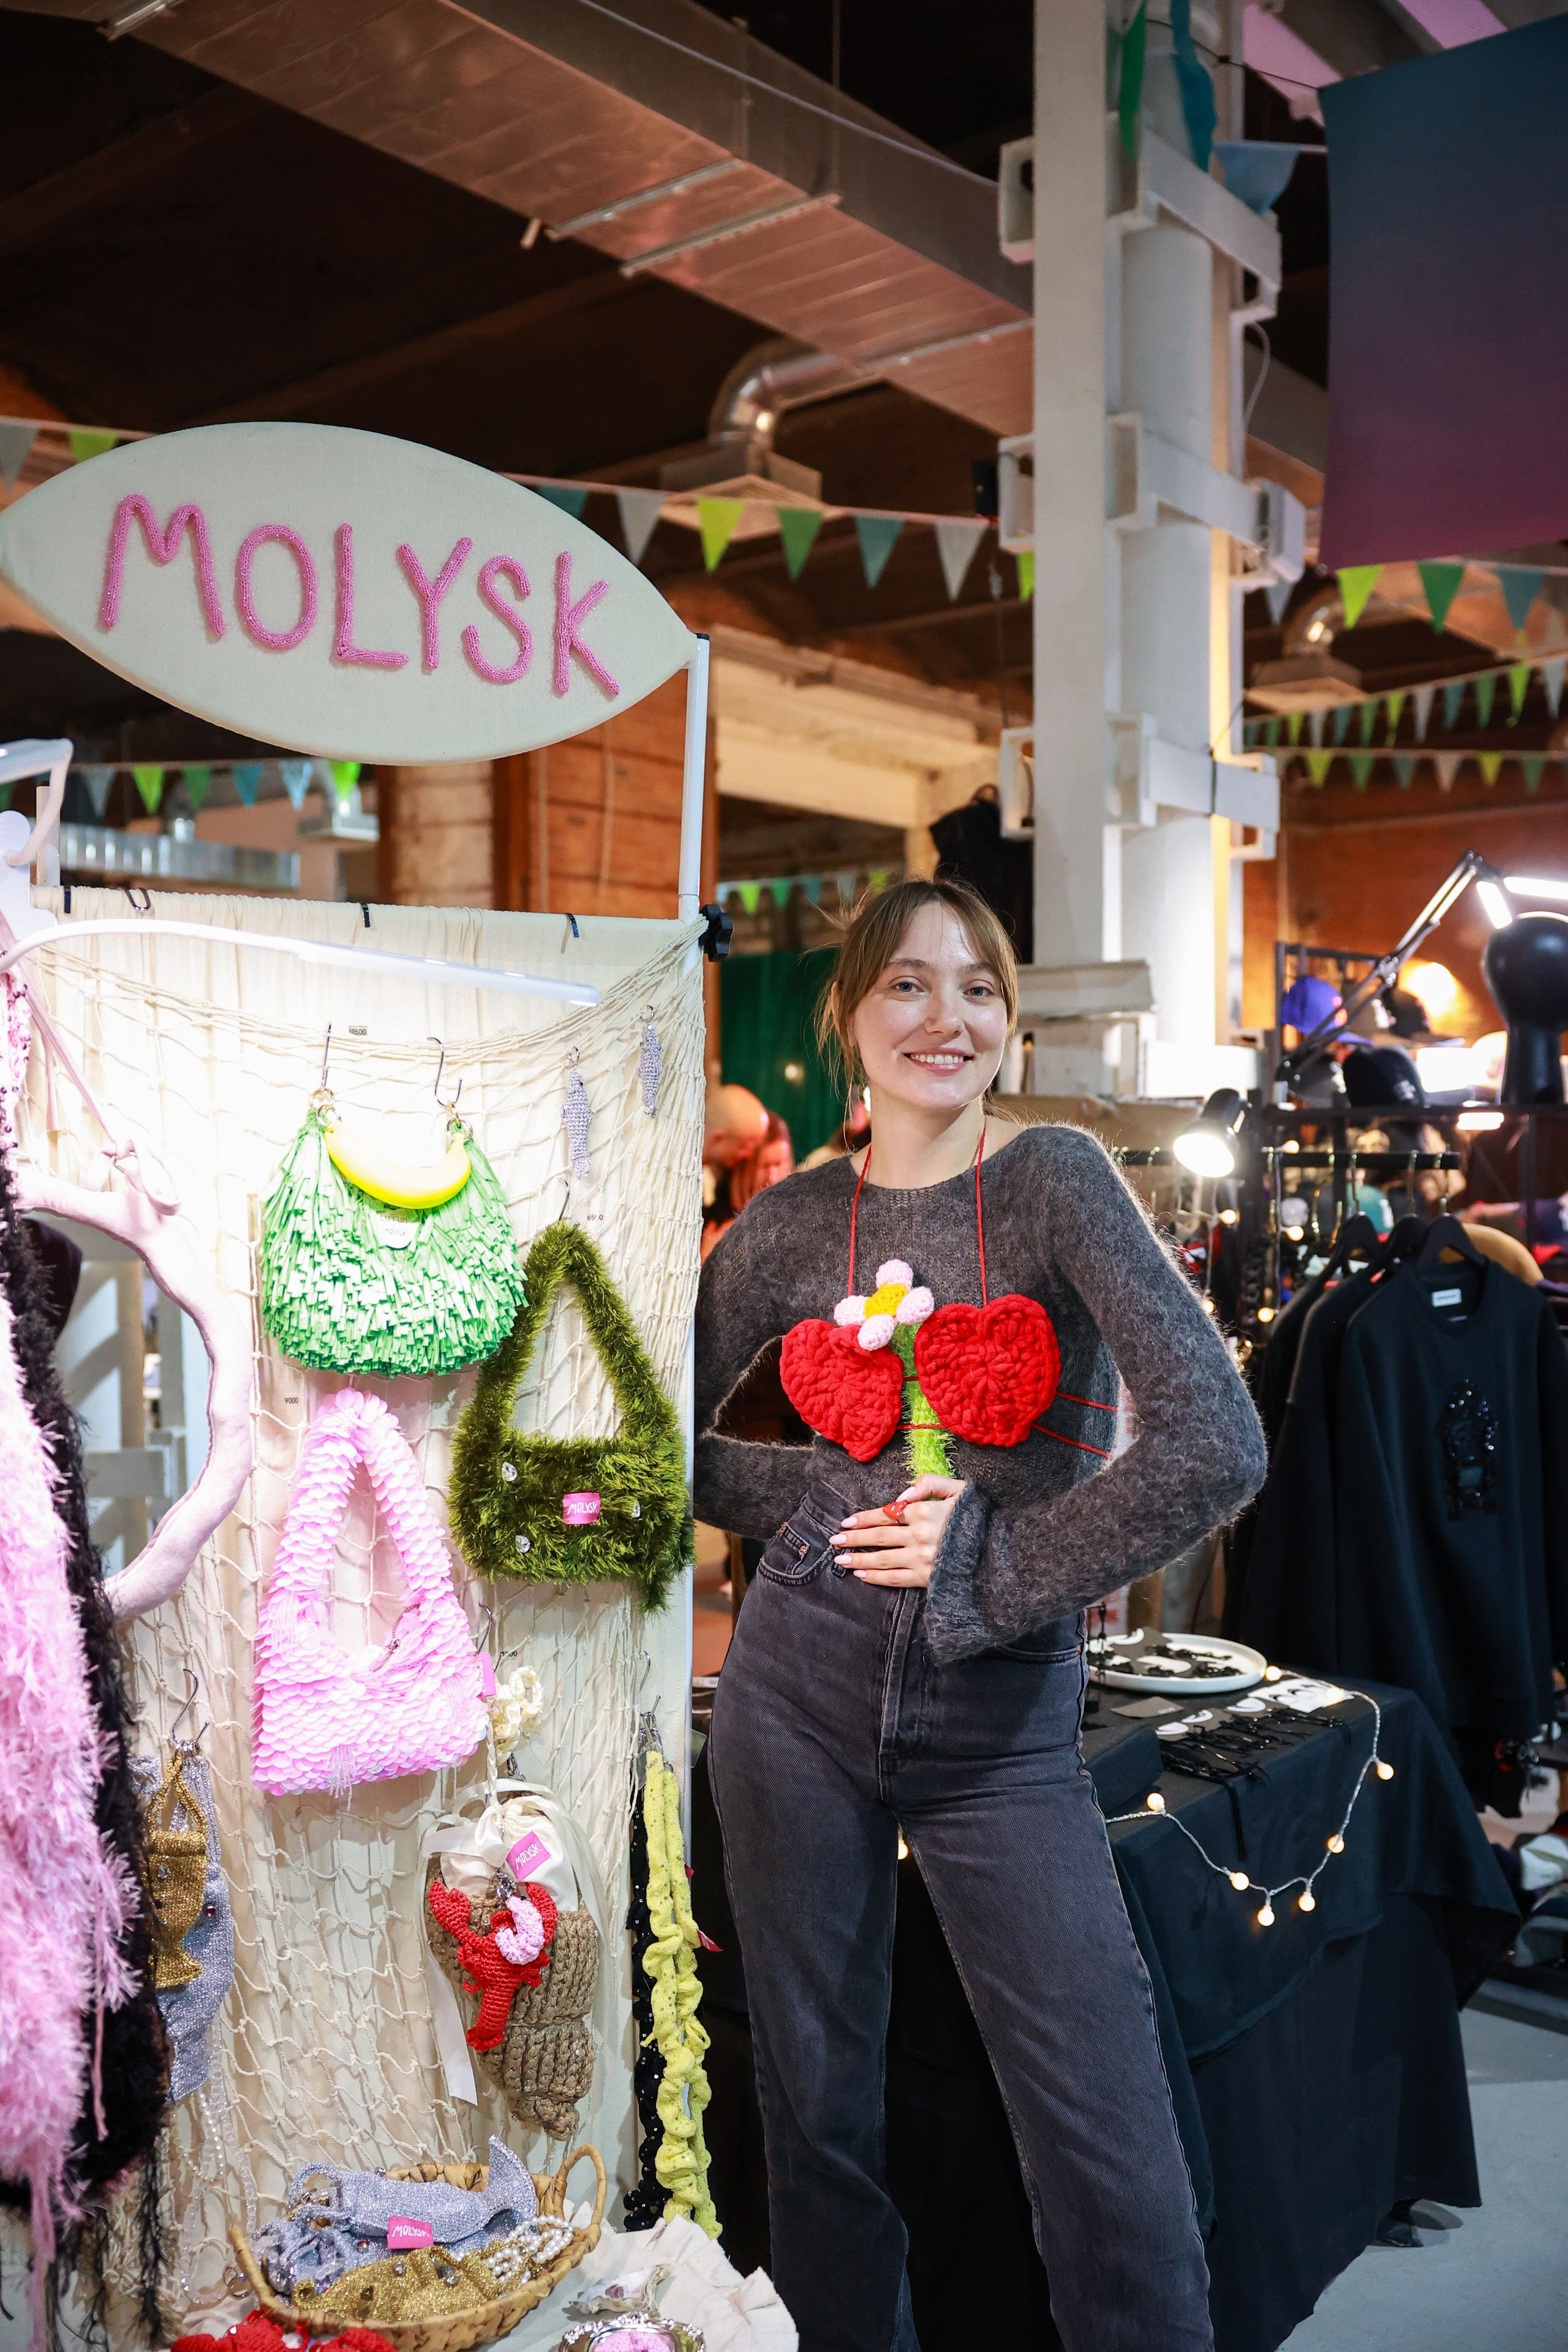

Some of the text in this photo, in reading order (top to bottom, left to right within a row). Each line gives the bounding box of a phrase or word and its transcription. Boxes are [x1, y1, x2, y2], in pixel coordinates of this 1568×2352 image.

[99, 494, 620, 696] MOLYSK
[567, 1501, 598, 1515] MOLYSK
[647, 1758, 658, 1771] 1800
[515, 1843, 543, 1871] MOLYSK
[391, 2225, 430, 2237] MOLYSK
